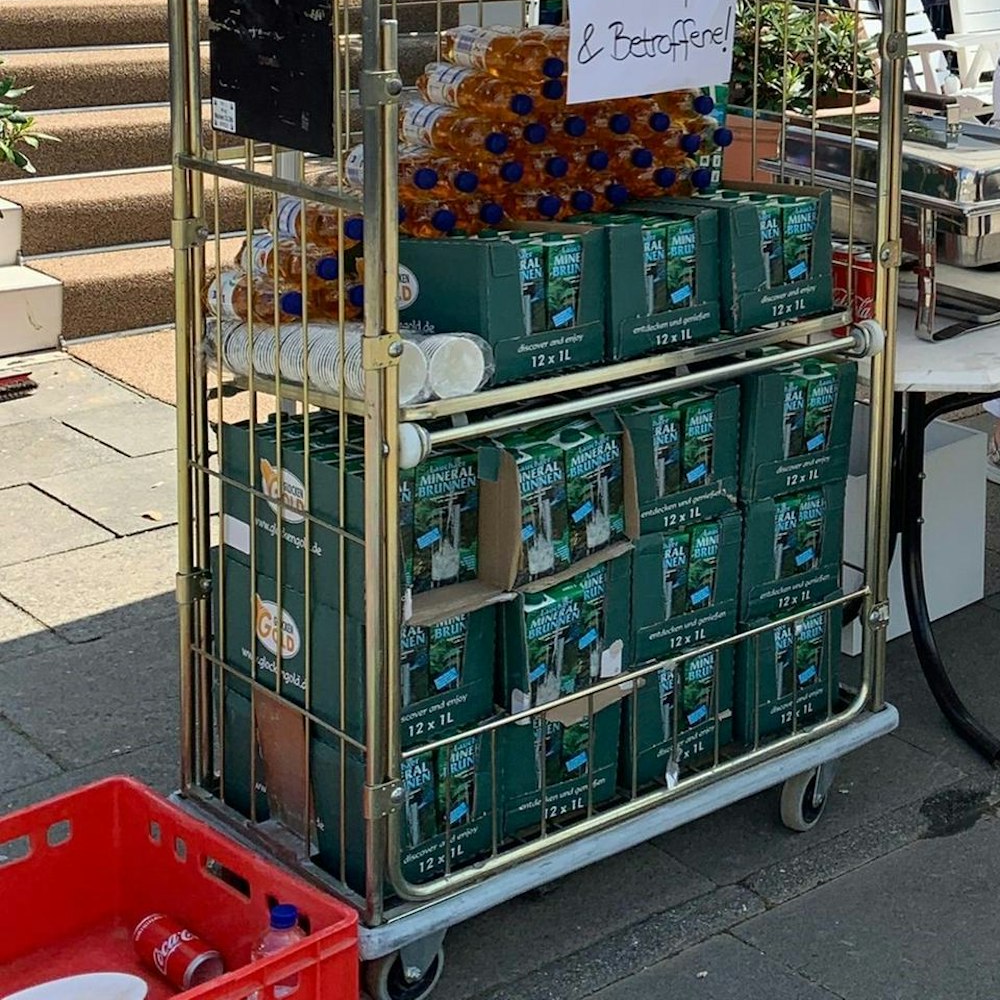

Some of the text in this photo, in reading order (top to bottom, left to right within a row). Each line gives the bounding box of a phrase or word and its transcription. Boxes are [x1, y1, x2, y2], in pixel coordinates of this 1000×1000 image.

[577, 5, 732, 65] & Betroffene!
[787, 211, 817, 224] MINE
[672, 233, 696, 245] MINE
[554, 252, 581, 266] MINE
[772, 299, 806, 317] 12 x 1L
[656, 328, 693, 346] 12 x 1L
[532, 349, 571, 368] 12 x 1L
[812, 385, 835, 398] MINE
[690, 411, 714, 426] MINE
[570, 447, 620, 478] BRUNNEN
[571, 439, 618, 467] MINERAL
[420, 465, 474, 487] MINERAL
[519, 461, 560, 483] INERAL
[520, 470, 563, 493] UNNEN
[786, 469, 819, 486] 12 x 1L
[417, 476, 477, 499] BRUNNEN
[800, 498, 824, 511] MINE
[663, 506, 702, 527] 12 x 1L
[778, 590, 811, 608] 12 x 1L
[528, 610, 581, 640] BRUNNEN
[530, 603, 579, 629] MINERAL
[801, 616, 824, 631] MINE
[670, 628, 707, 649] 12 x 1L
[690, 653, 714, 671] MINE
[401, 707, 427, 723] scover
[428, 700, 446, 714] and
[781, 711, 793, 724] 12
[803, 702, 813, 715] 1L
[408, 711, 454, 737] 12 x 1L
[693, 742, 705, 754] 1L
[560, 804, 567, 814] x
[571, 797, 584, 810] 1L
[440, 834, 456, 848] ad
[419, 844, 465, 873] 12 x 1L
